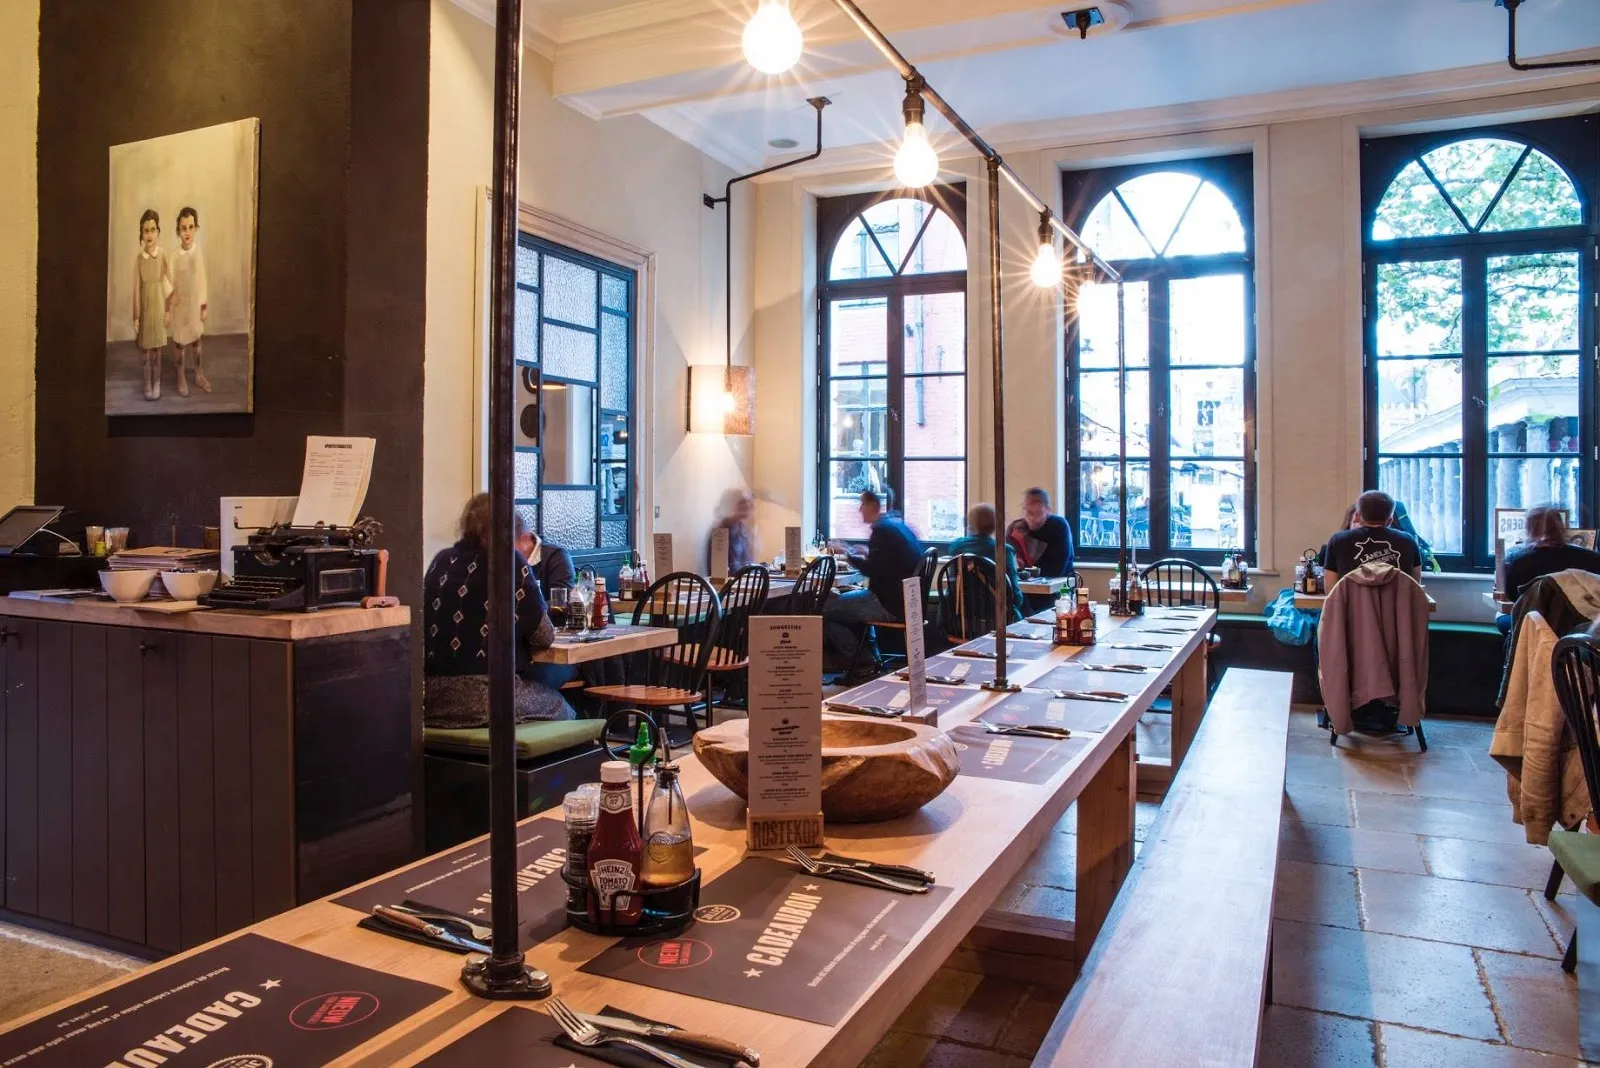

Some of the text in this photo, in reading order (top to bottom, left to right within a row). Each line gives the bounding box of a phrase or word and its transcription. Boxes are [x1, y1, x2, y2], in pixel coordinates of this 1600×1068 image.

[599, 876, 628, 886] TOMATO
[600, 865, 626, 875] HEINZ
[746, 892, 822, 966] CADEAUBON
[320, 996, 362, 1024] NIEUW
[103, 991, 262, 1068] CADEAU
